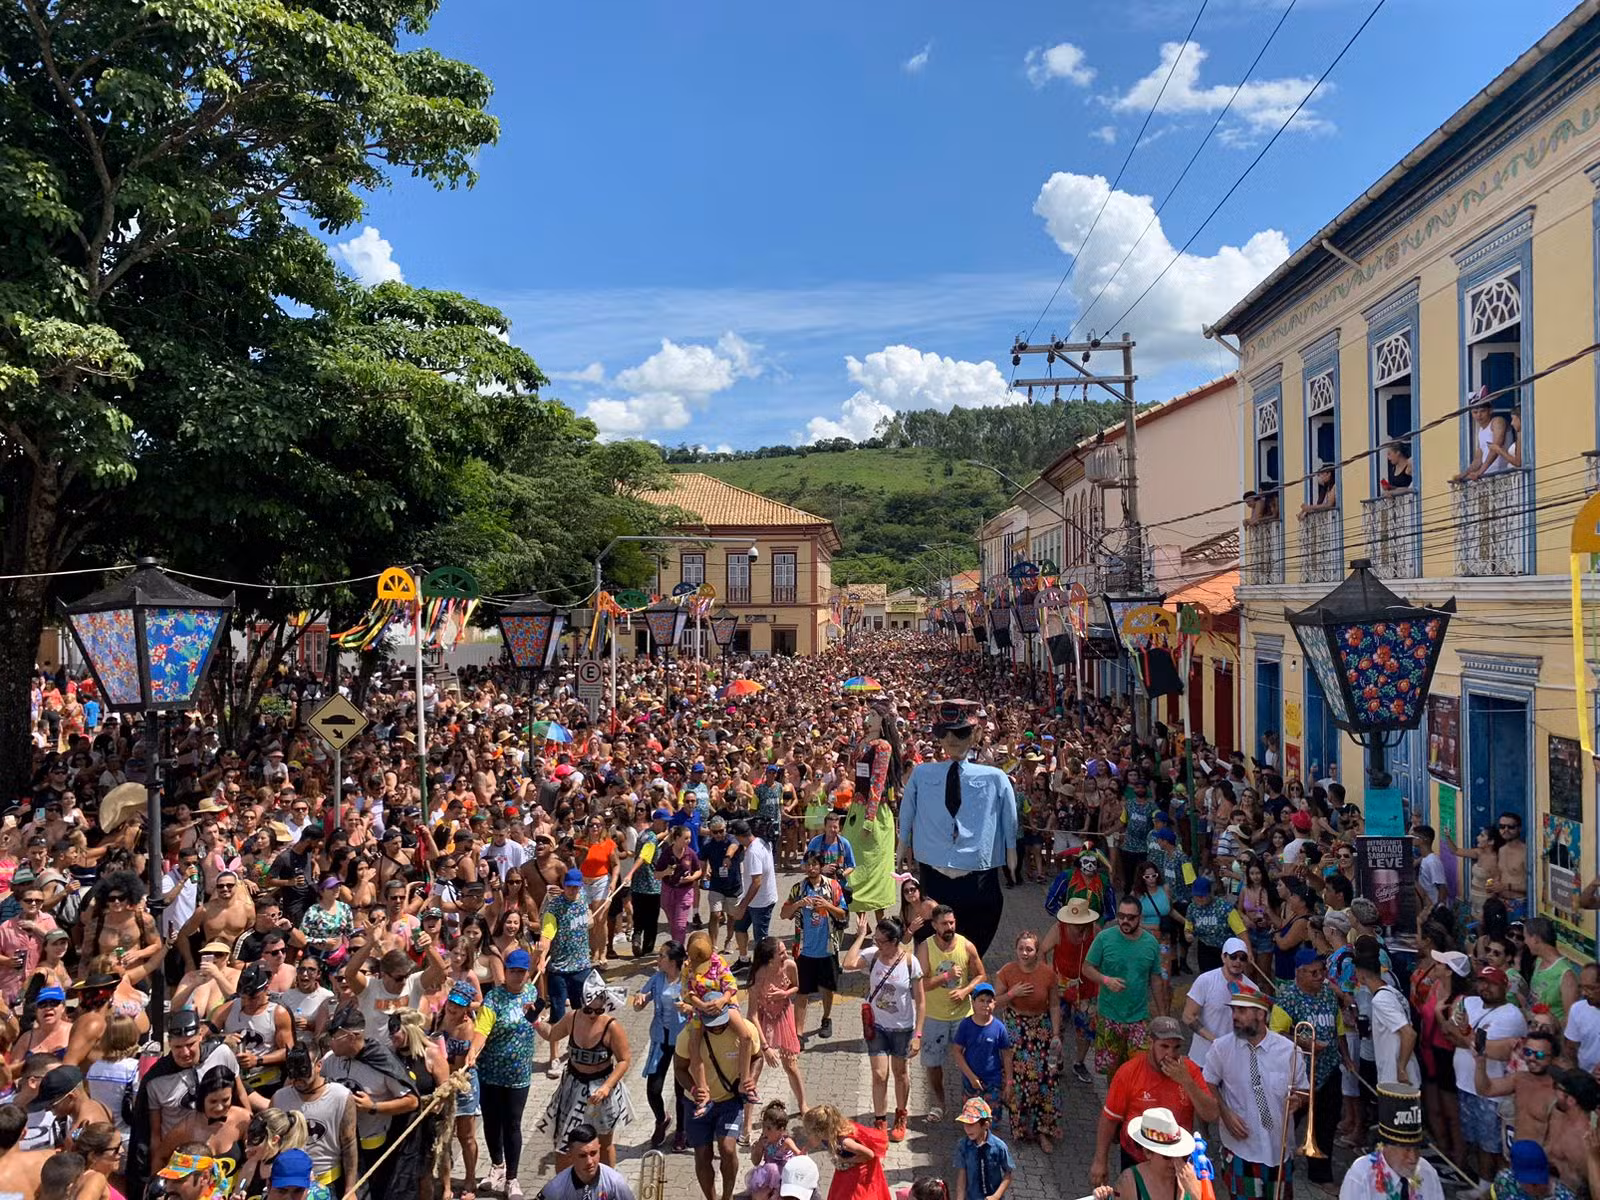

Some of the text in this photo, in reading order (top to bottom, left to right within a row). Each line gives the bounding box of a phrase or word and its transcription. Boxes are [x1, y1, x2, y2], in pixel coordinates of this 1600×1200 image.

[587, 666, 595, 678] E
[1367, 845, 1403, 853] FRUTADO
[1368, 857, 1404, 868] LEVE
